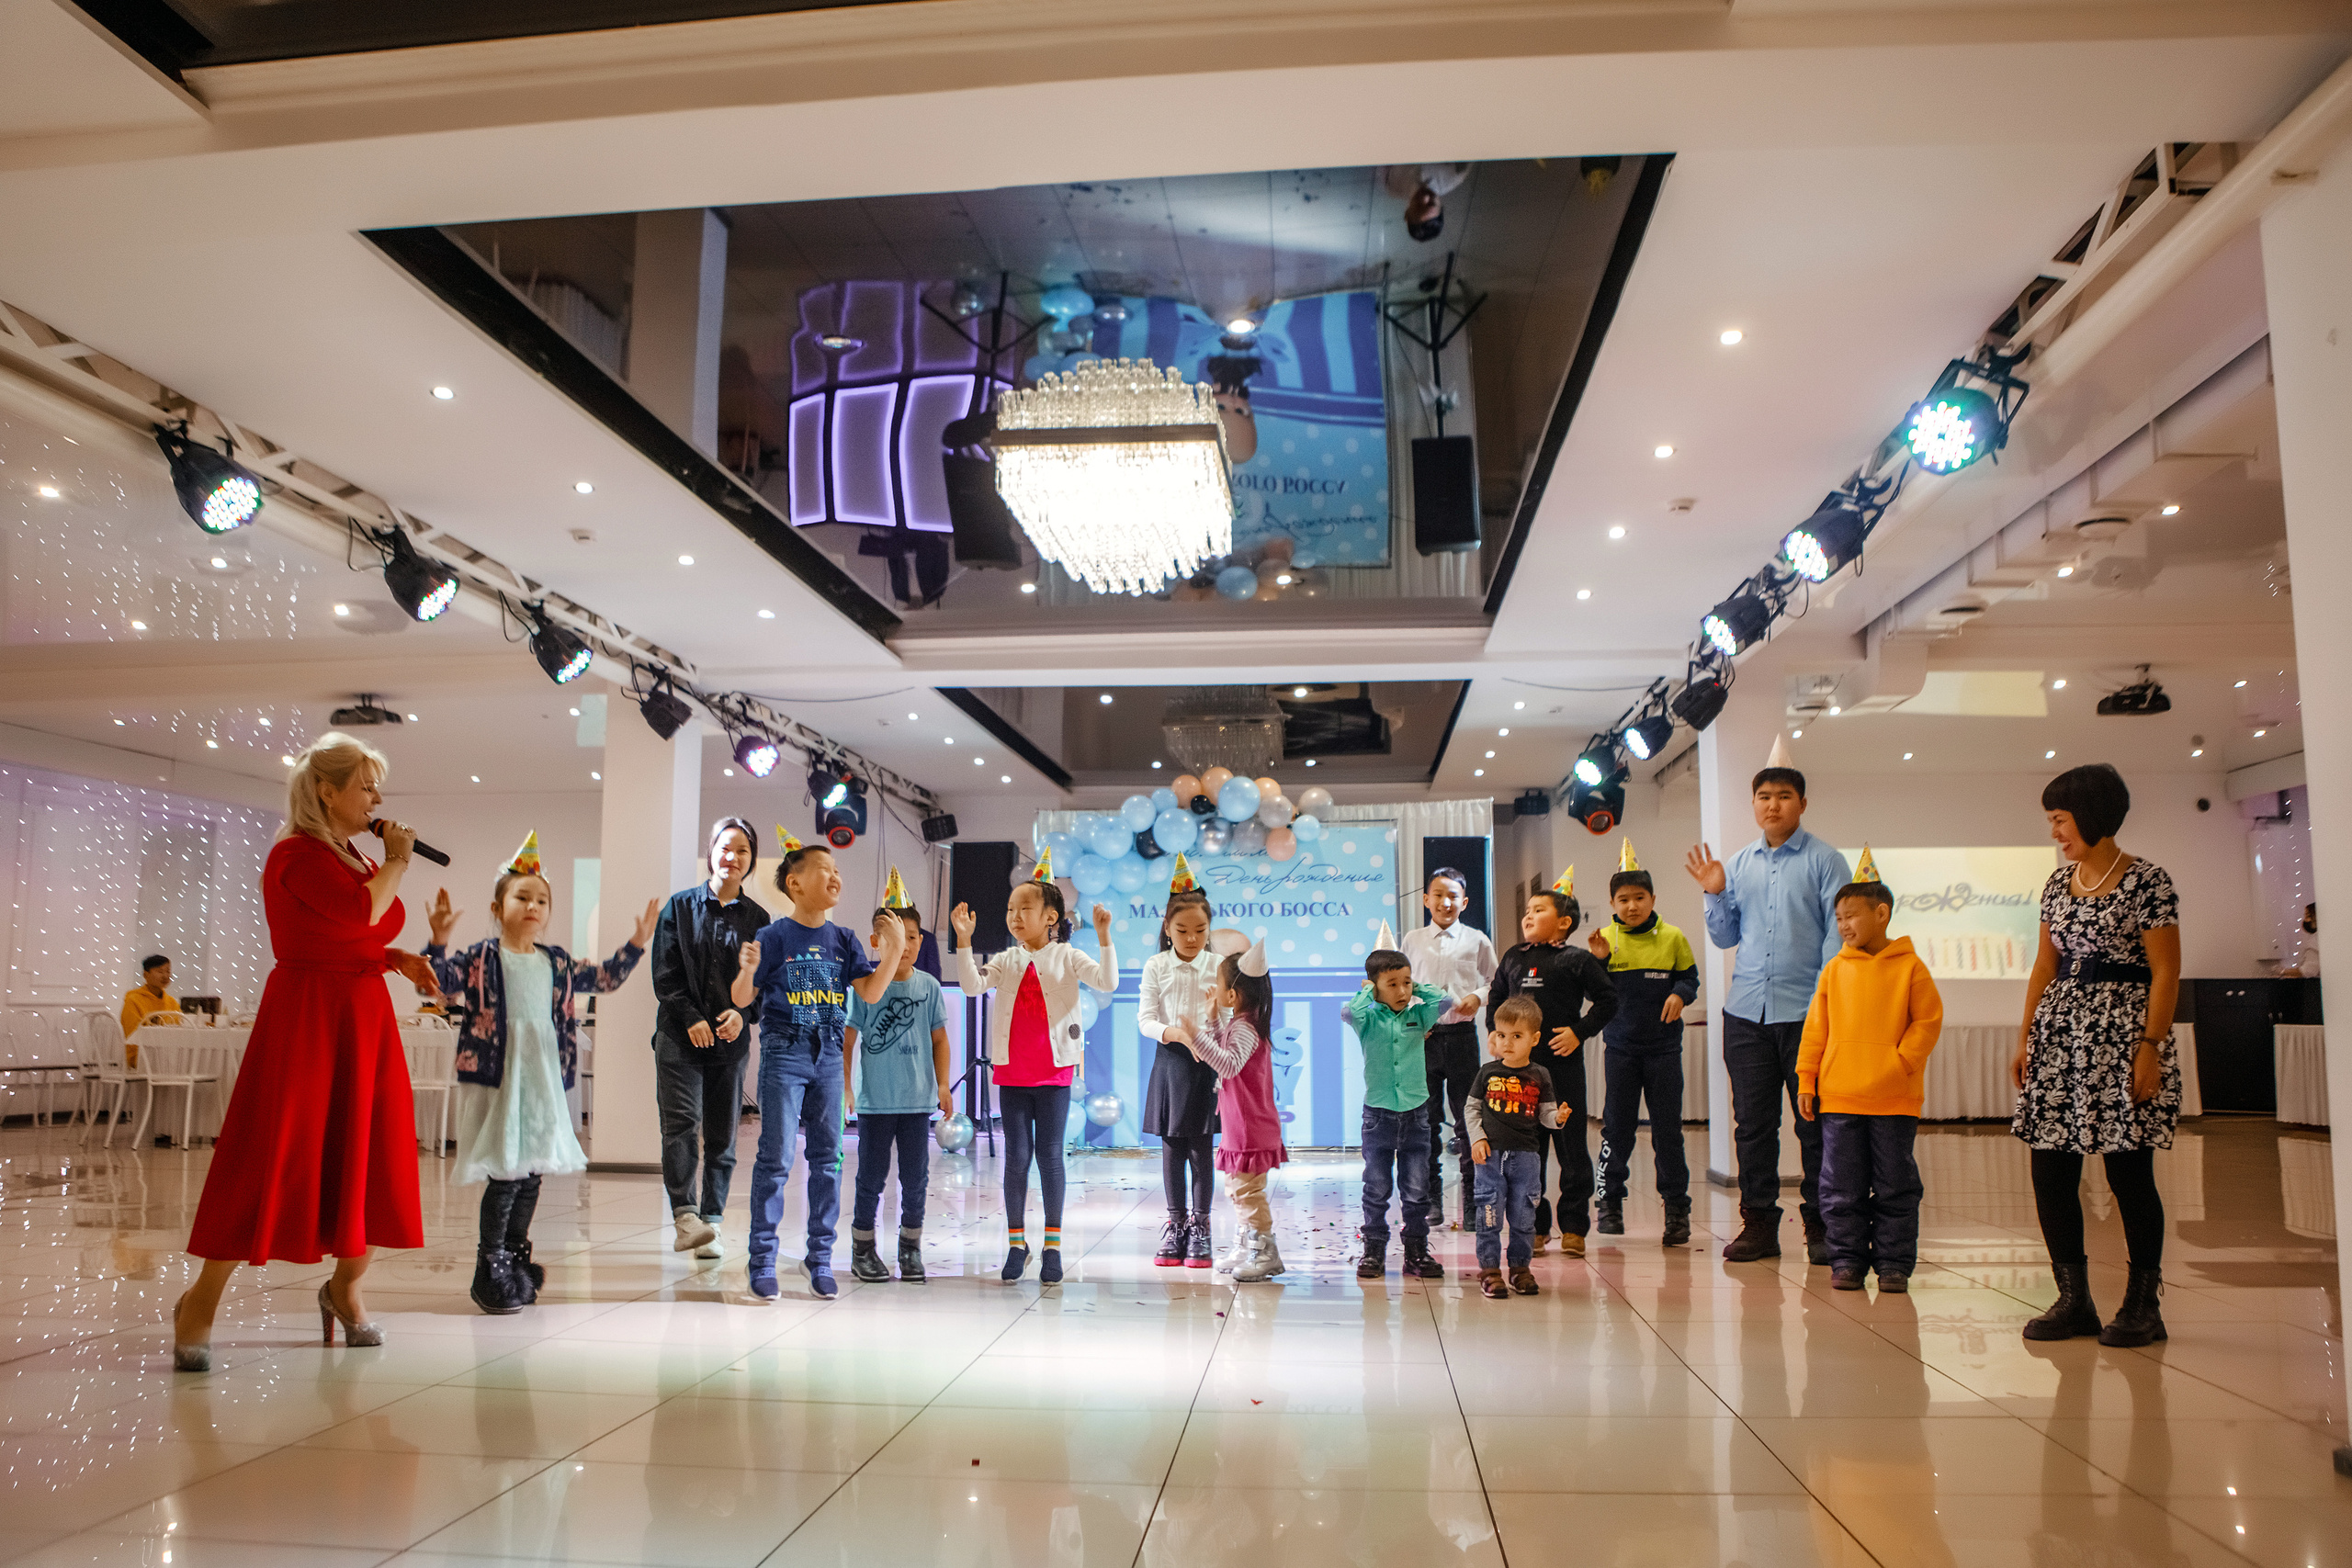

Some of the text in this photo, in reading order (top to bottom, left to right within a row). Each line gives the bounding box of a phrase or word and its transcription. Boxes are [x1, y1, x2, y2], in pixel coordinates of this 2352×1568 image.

[1129, 902, 1350, 918] МАКОГО БОССА
[786, 989, 844, 1007] WINNER
